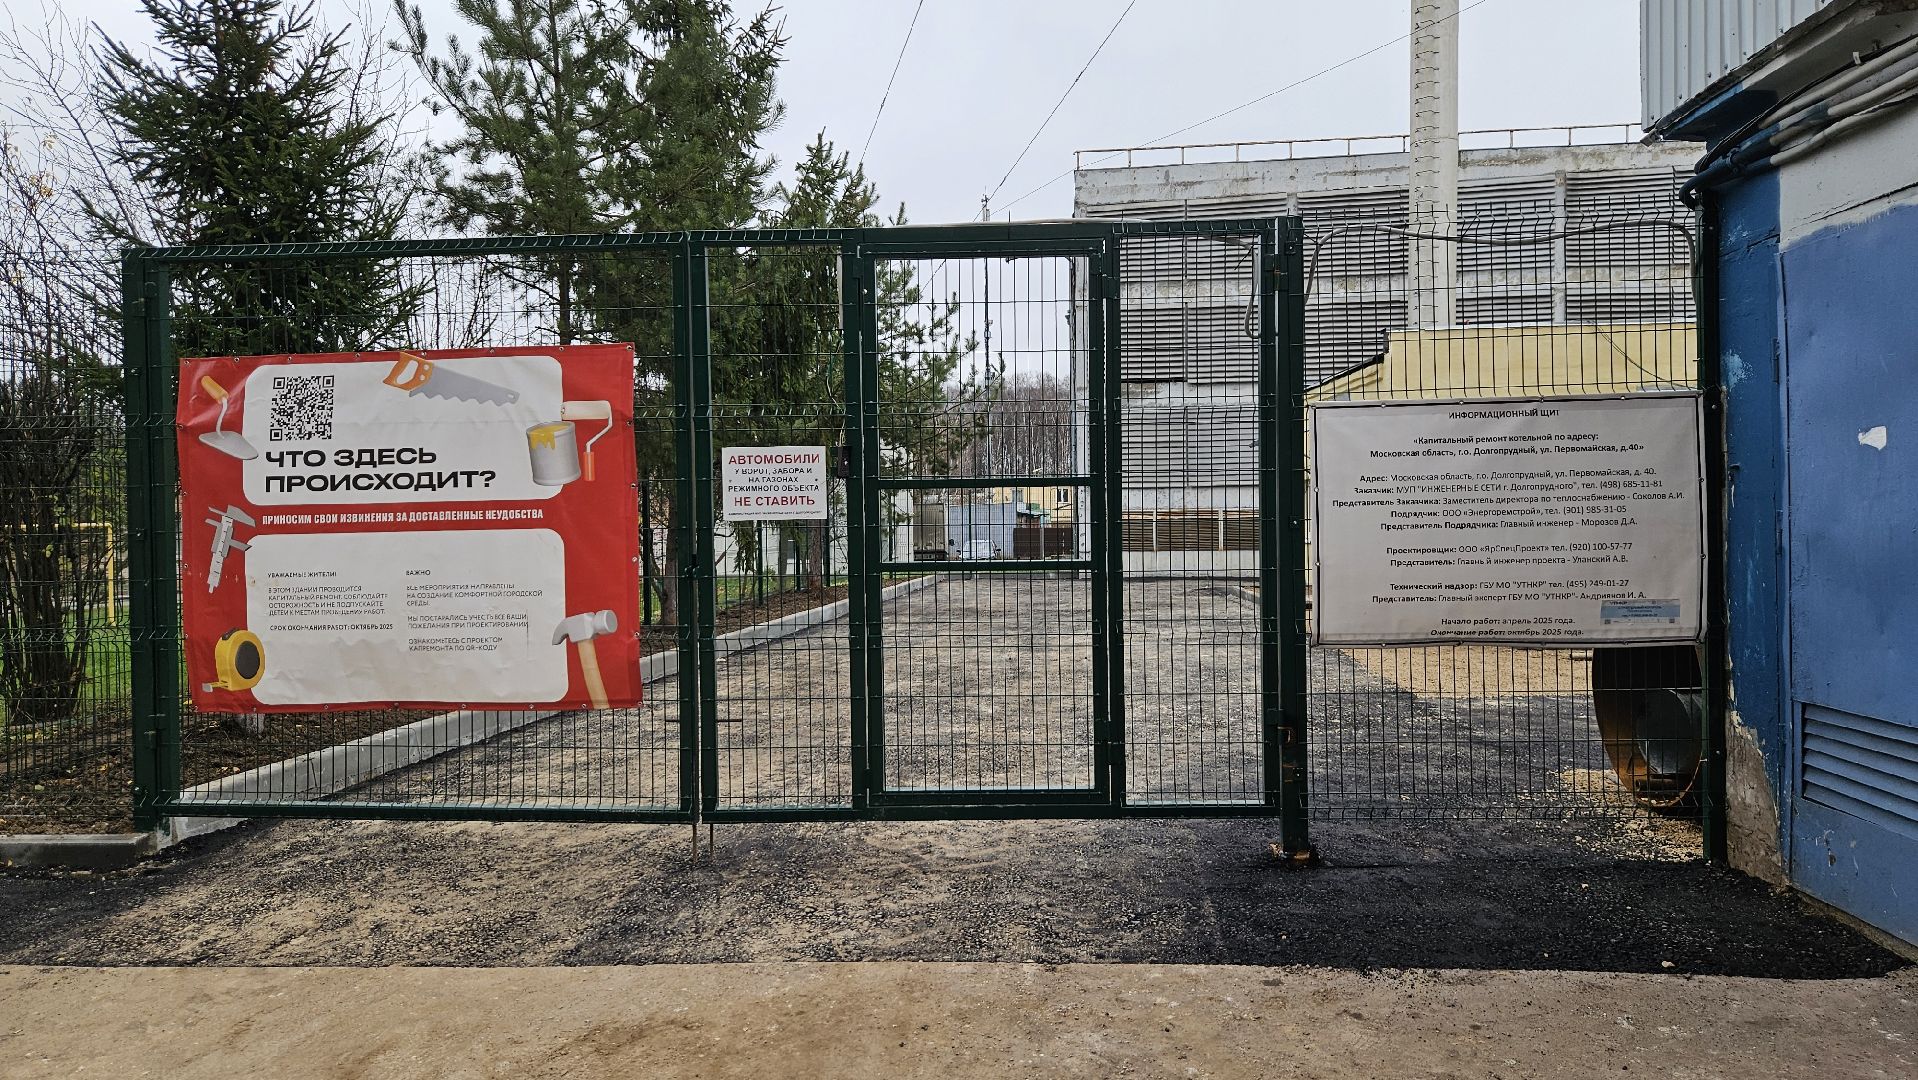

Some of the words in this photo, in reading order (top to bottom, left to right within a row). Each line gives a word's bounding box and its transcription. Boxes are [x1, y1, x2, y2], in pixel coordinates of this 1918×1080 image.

[1449, 408, 1538, 419] ИНФОРМАЦИОННЫЙ
[1541, 410, 1560, 418] ЩИТ
[1414, 436, 1473, 444] «Капитальный
[1476, 436, 1507, 444] ремонт
[1509, 434, 1552, 442] котельной
[1567, 433, 1598, 441] адресу:
[1371, 449, 1419, 457] Московская
[1474, 446, 1537, 456] Долгопрудный,
[1555, 445, 1618, 453] Первомайская,
[1620, 444, 1644, 452] д.40»
[266, 450, 326, 467] ЧТО
[334, 448, 436, 468] ЗДЕСЬ
[729, 454, 819, 464] АВТОМОБИЛИ
[266, 471, 496, 492] ПРОИСХОДИТ?
[1360, 475, 1387, 483] Адрес:
[1391, 473, 1438, 481] Московская
[1491, 470, 1553, 480] Долгопрудный,
[1570, 468, 1631, 477] Первомайская,
[1397, 485, 1415, 493] МУП
[1600, 481, 1620, 489] (498)
[1623, 480, 1662, 488] 685-11-81
[735, 497, 751, 506] НЕ
[756, 496, 815, 506] СТАВИТЬ
[1443, 496, 1494, 504] Заместитель
[1496, 495, 1538, 504] директора
[1633, 492, 1666, 500] Соколов
[261, 513, 313, 526] ПРИНОСИМ
[313, 512, 339, 525] СВОИ
[339, 511, 395, 524] ИЗВИНЕНИЯ
[395, 511, 409, 523] ЗА
[408, 509, 484, 524] ДОСТАВЛЕННЫЕ
[484, 508, 545, 521] НЕУДОБСТВА
[1564, 507, 1583, 515] (901)
[1621, 518, 1637, 526] Д.А.
[1387, 547, 1456, 555] Проектировщик:
[1570, 543, 1590, 551] (920)
[1593, 542, 1632, 550] 100-57-77
[1391, 559, 1455, 567] Представитель:
[1572, 555, 1610, 563] Уланский
[1567, 580, 1587, 588] (495)
